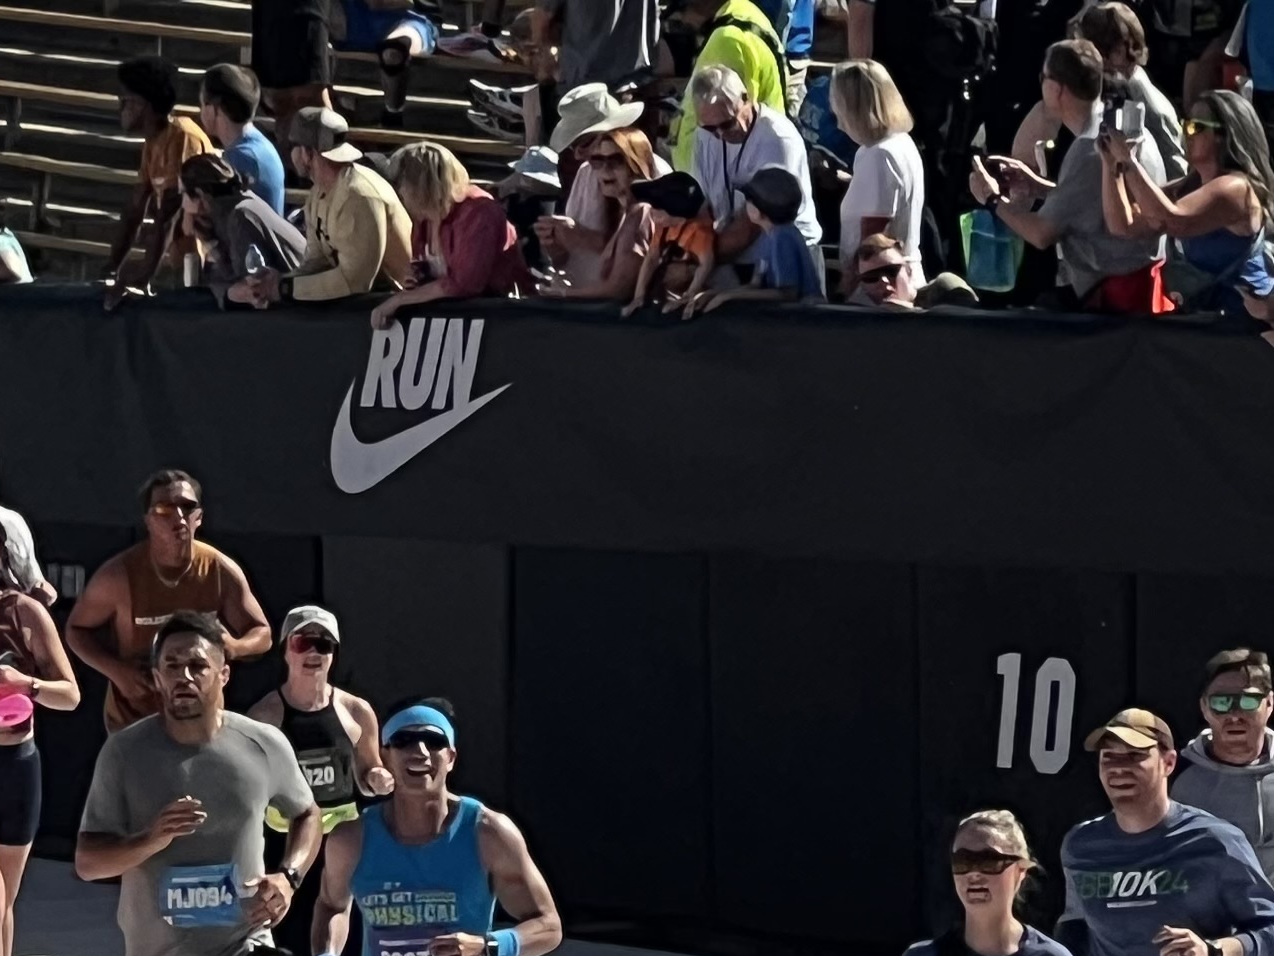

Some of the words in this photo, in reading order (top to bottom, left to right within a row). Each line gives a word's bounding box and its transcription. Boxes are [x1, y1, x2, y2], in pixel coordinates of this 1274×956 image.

[360, 317, 485, 411] RUN
[996, 652, 1076, 775] 10
[167, 885, 233, 910] MJ094
